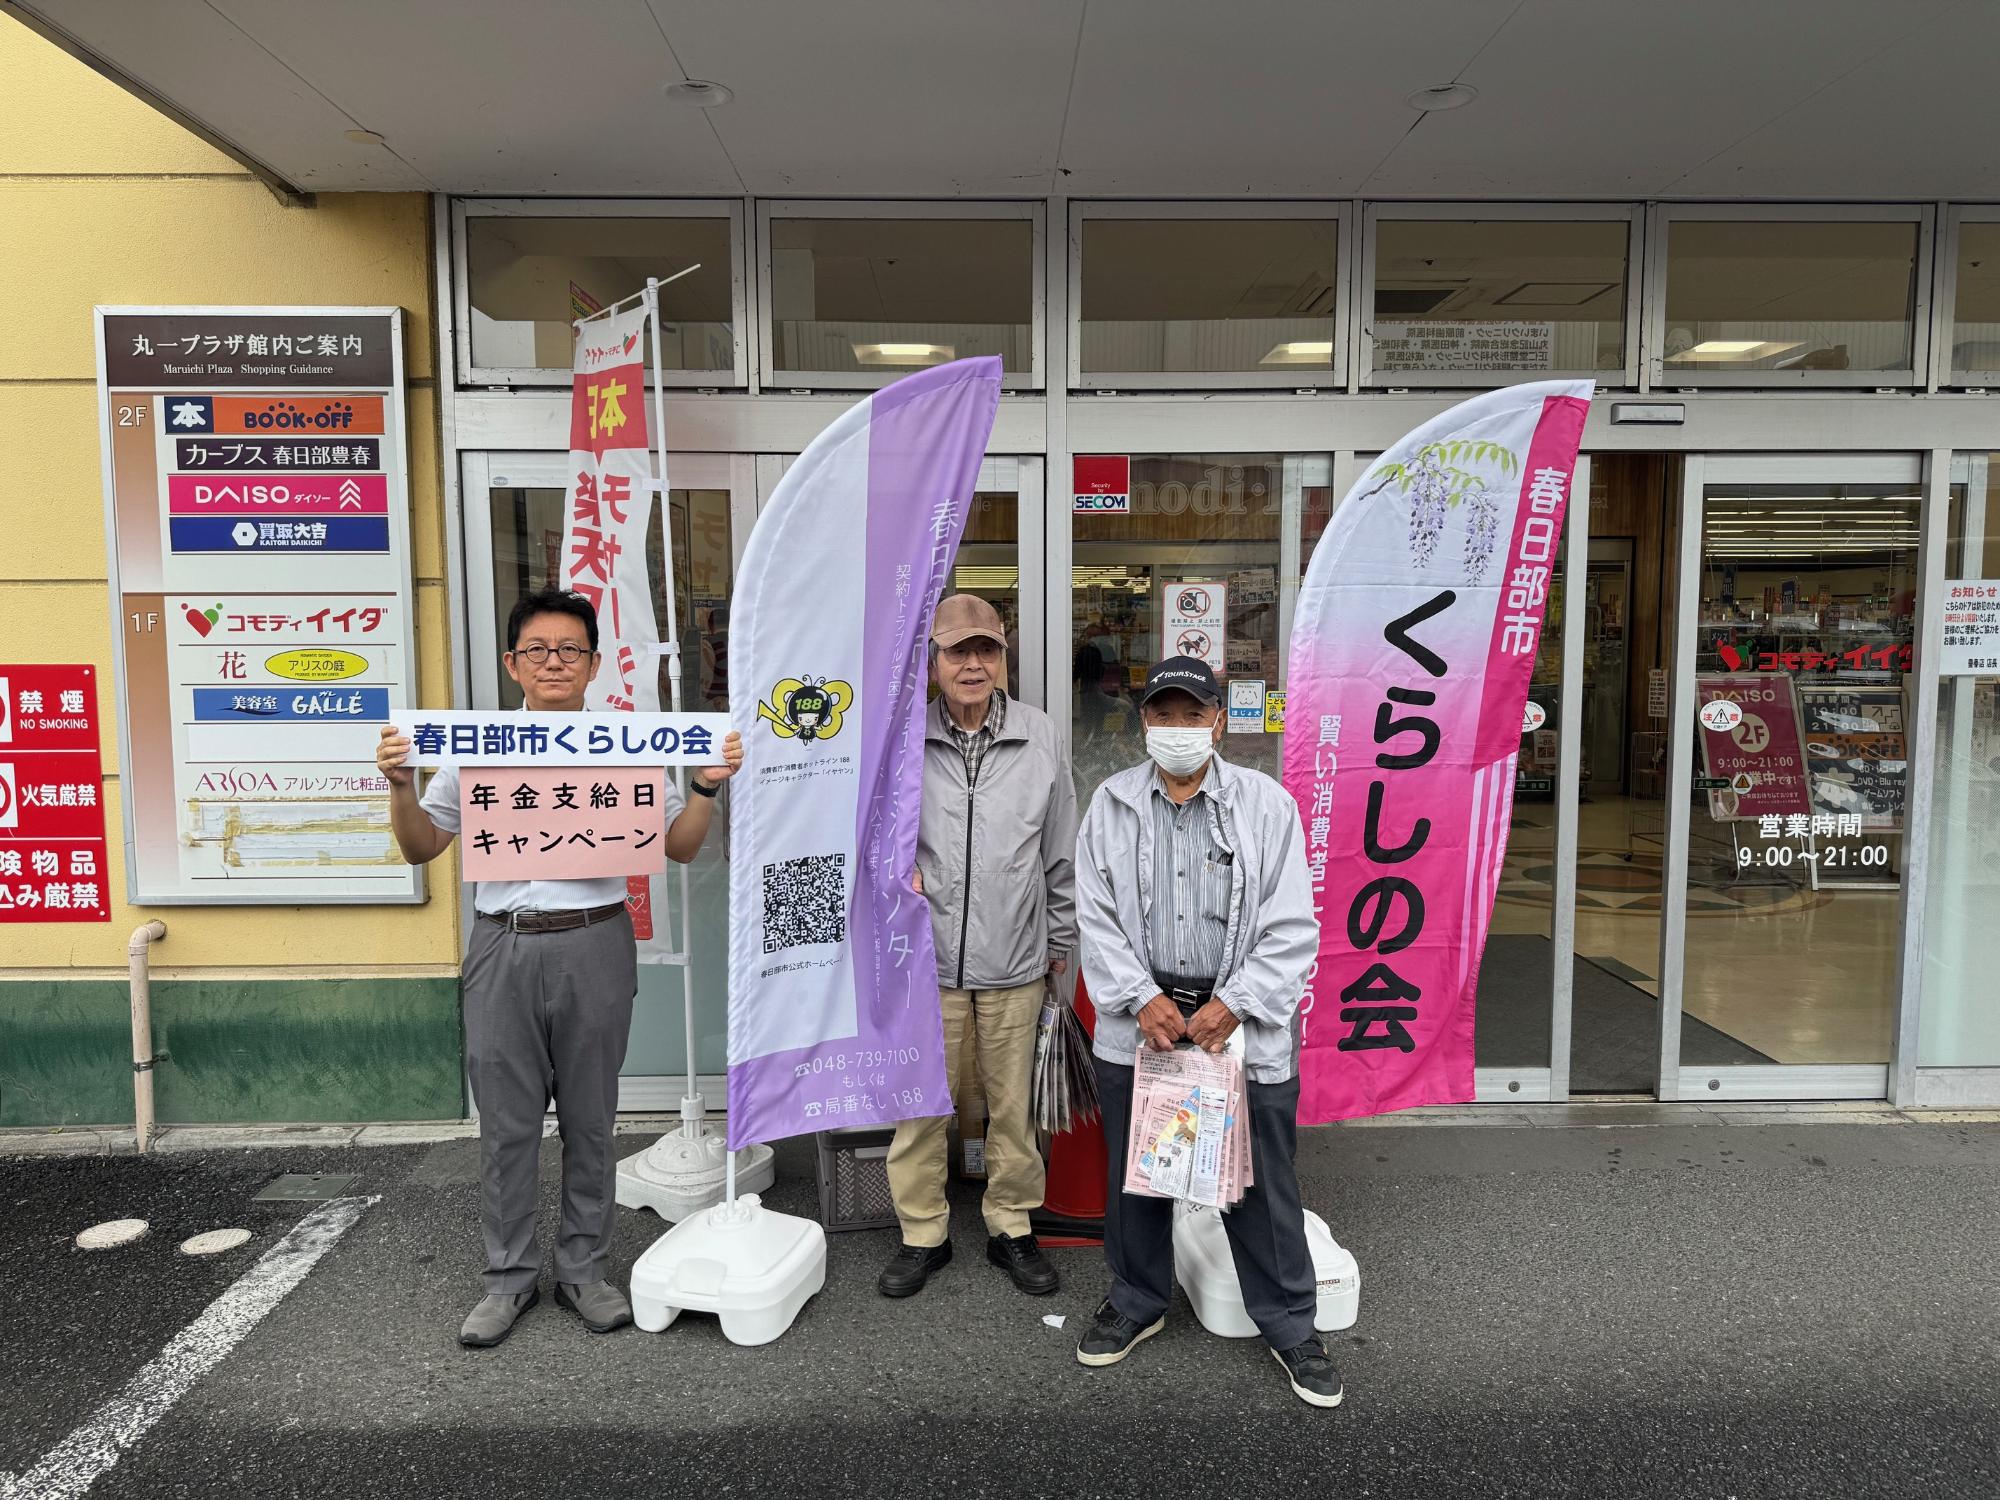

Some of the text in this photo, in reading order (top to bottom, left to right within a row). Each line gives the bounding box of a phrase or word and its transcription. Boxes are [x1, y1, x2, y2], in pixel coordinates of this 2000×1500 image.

[132, 333, 363, 358] 丸一プラザ館内ご案内
[163, 363, 334, 376] Maruichi Plaza Shopping Guidance
[117, 405, 148, 428] 2F
[172, 401, 206, 428] 本
[185, 444, 371, 465] カーブス 春日部豊春
[195, 486, 331, 504] DAISO ダイソー
[1075, 495, 1126, 509] SECOM
[259, 522, 328, 540] 買取大吉
[1501, 466, 1568, 656] 春日部市
[1951, 586, 1998, 598] お知らせ
[130, 612, 159, 633] 1F
[227, 607, 389, 633] コモディイイダ
[217, 651, 247, 680] 花
[288, 660, 345, 671] アリスの庭
[1164, 670, 1206, 682] TOURSTAGE
[19, 690, 85, 713] 禁煙
[231, 695, 278, 711] 美容室
[795, 697, 823, 711] 188
[1711, 689, 1776, 703] DAISO
[20, 718, 89, 730] NO SMOKING
[1738, 722, 1765, 745] 2F
[413, 723, 713, 756] 春日部市くらしの会
[195, 767, 389, 797] ARSOA アルソア化粧品
[21, 784, 97, 807] 火気厳禁
[469, 782, 656, 811] 年金支給日
[1337, 589, 1456, 1054] くらしの会
[1758, 813, 1862, 838] 営業時間
[473, 828, 658, 855] キャンペーン
[812, 1047, 920, 1074] 048-739-7100
[842, 1073, 886, 1088] もしくは
[824, 1087, 923, 1115] 局番なし 188
